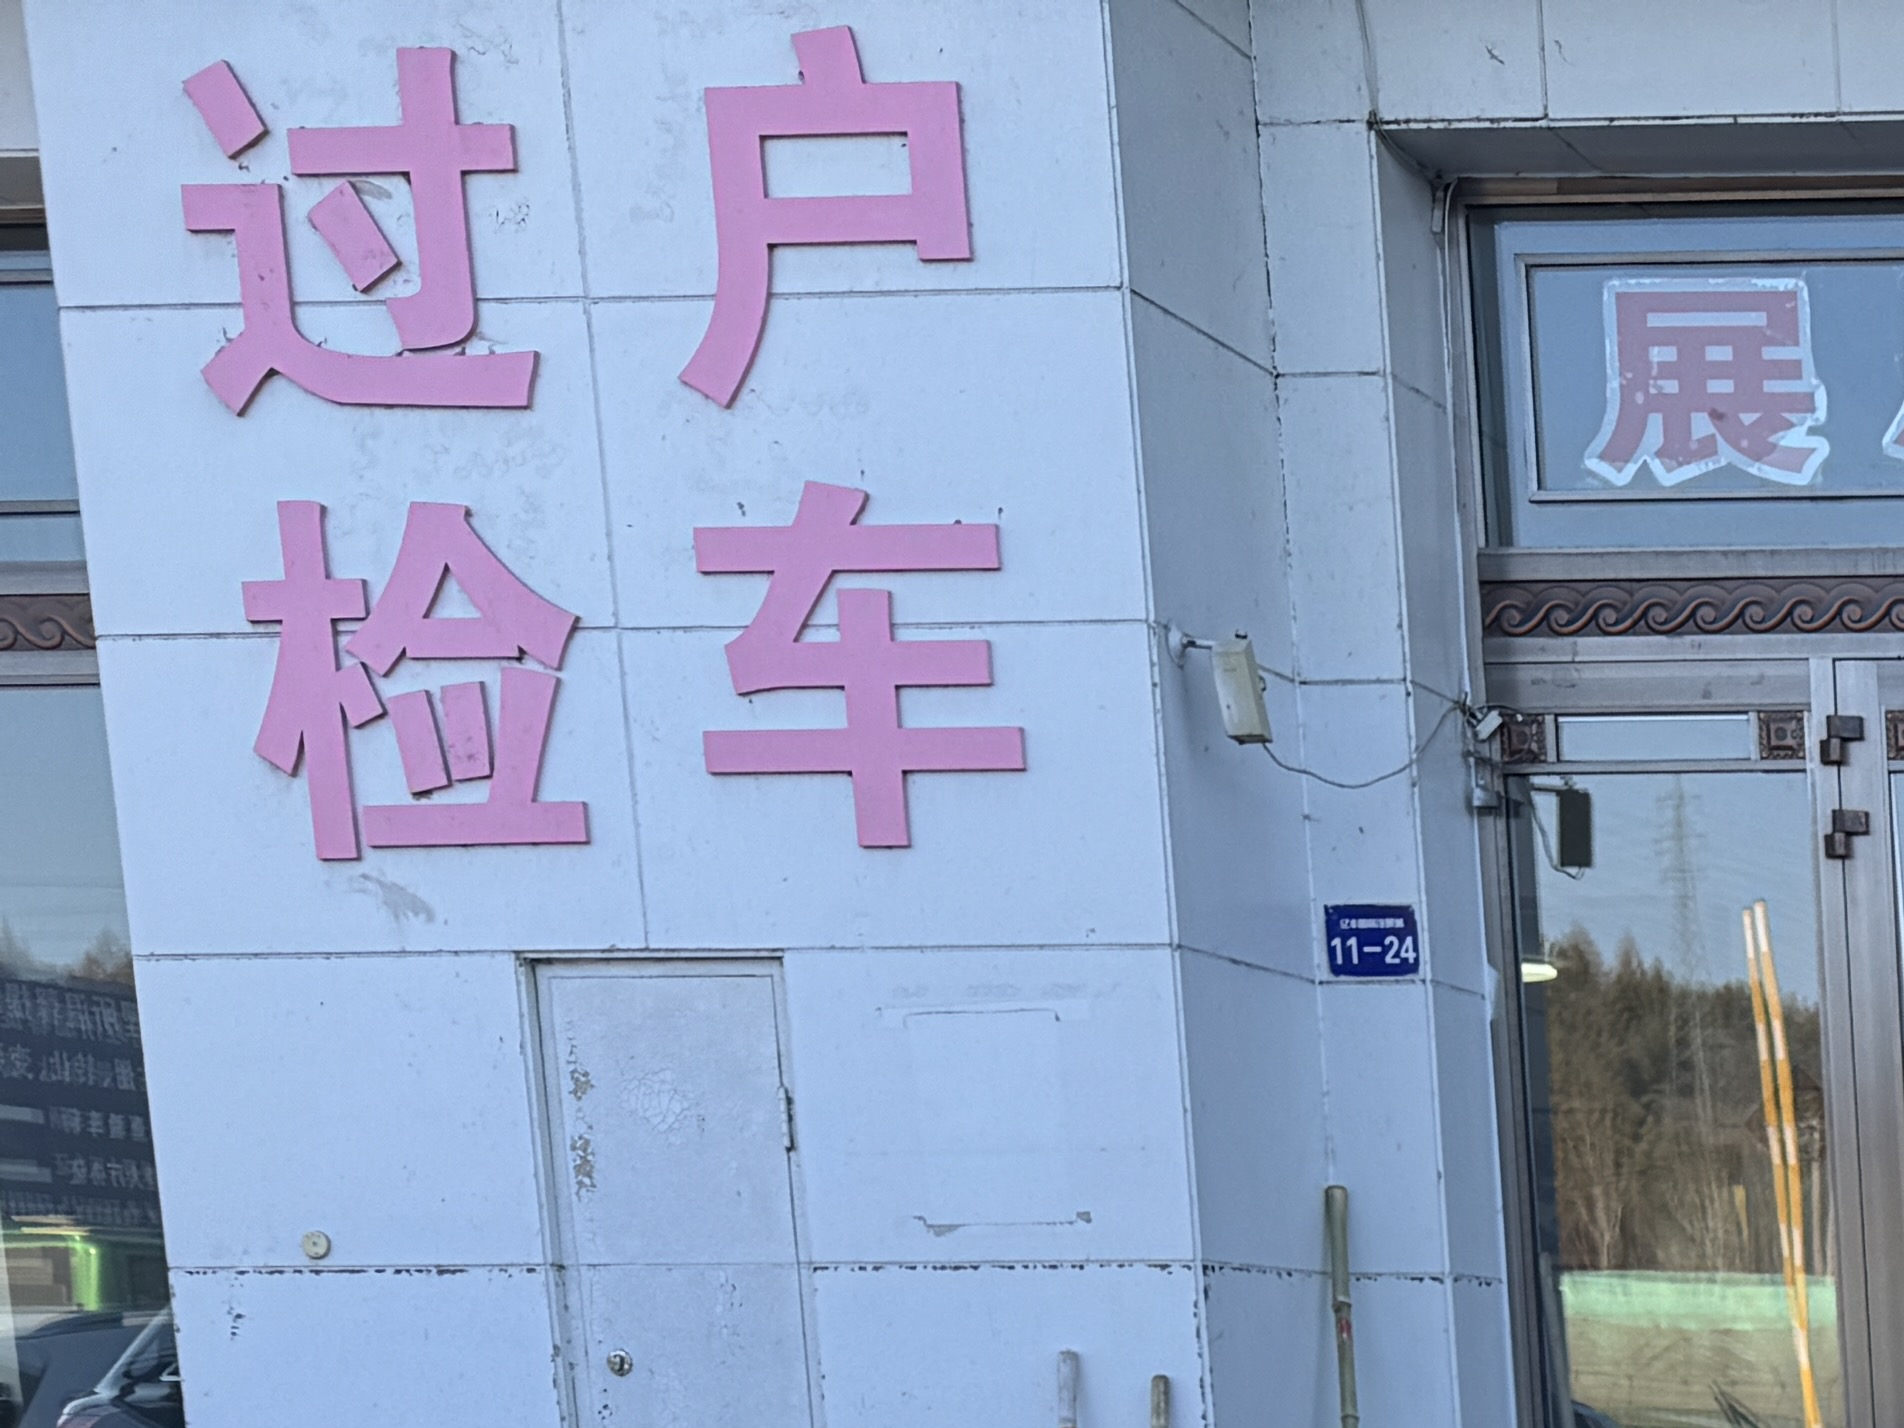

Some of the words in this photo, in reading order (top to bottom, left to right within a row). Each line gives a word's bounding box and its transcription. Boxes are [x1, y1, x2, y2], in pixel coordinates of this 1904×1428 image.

[181, 24, 974, 416] 过户
[241, 480, 1026, 862] 检车
[1330, 935, 1417, 966] 11-24
